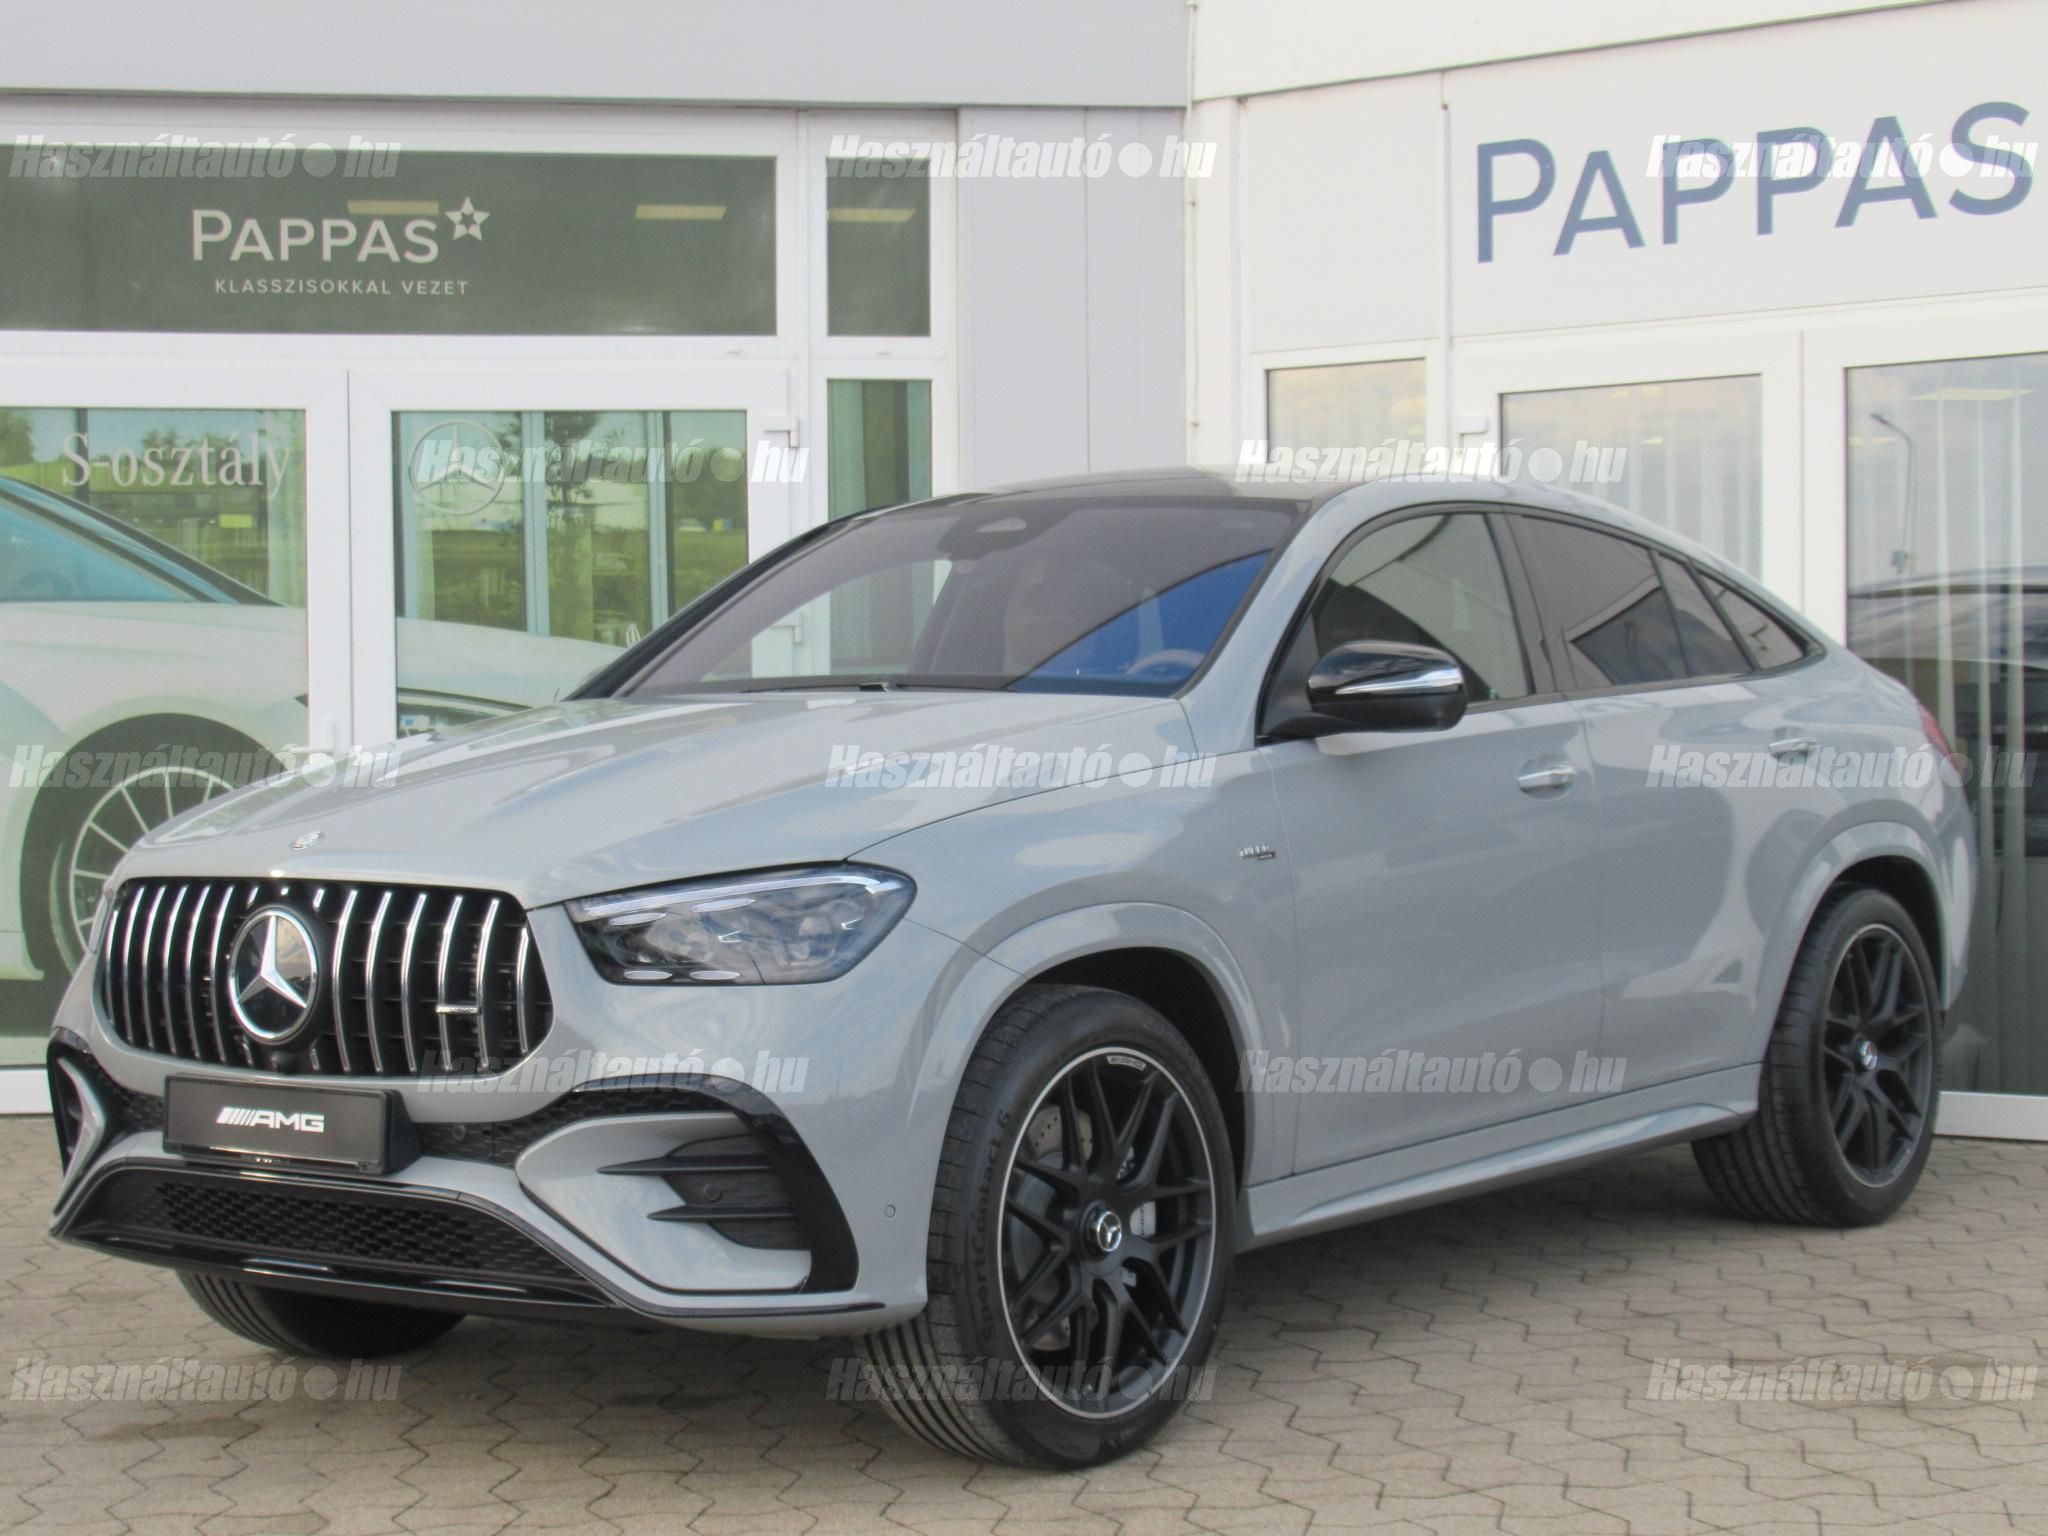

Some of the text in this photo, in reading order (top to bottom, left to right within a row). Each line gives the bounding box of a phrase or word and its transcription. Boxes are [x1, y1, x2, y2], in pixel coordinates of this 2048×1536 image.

[1477, 101, 2034, 264] PAPPAS
[193, 209, 439, 263] PAPPAS
[215, 279, 468, 295] KLASSZISOKKAL VEZET
[62, 431, 290, 500] S-osztály
